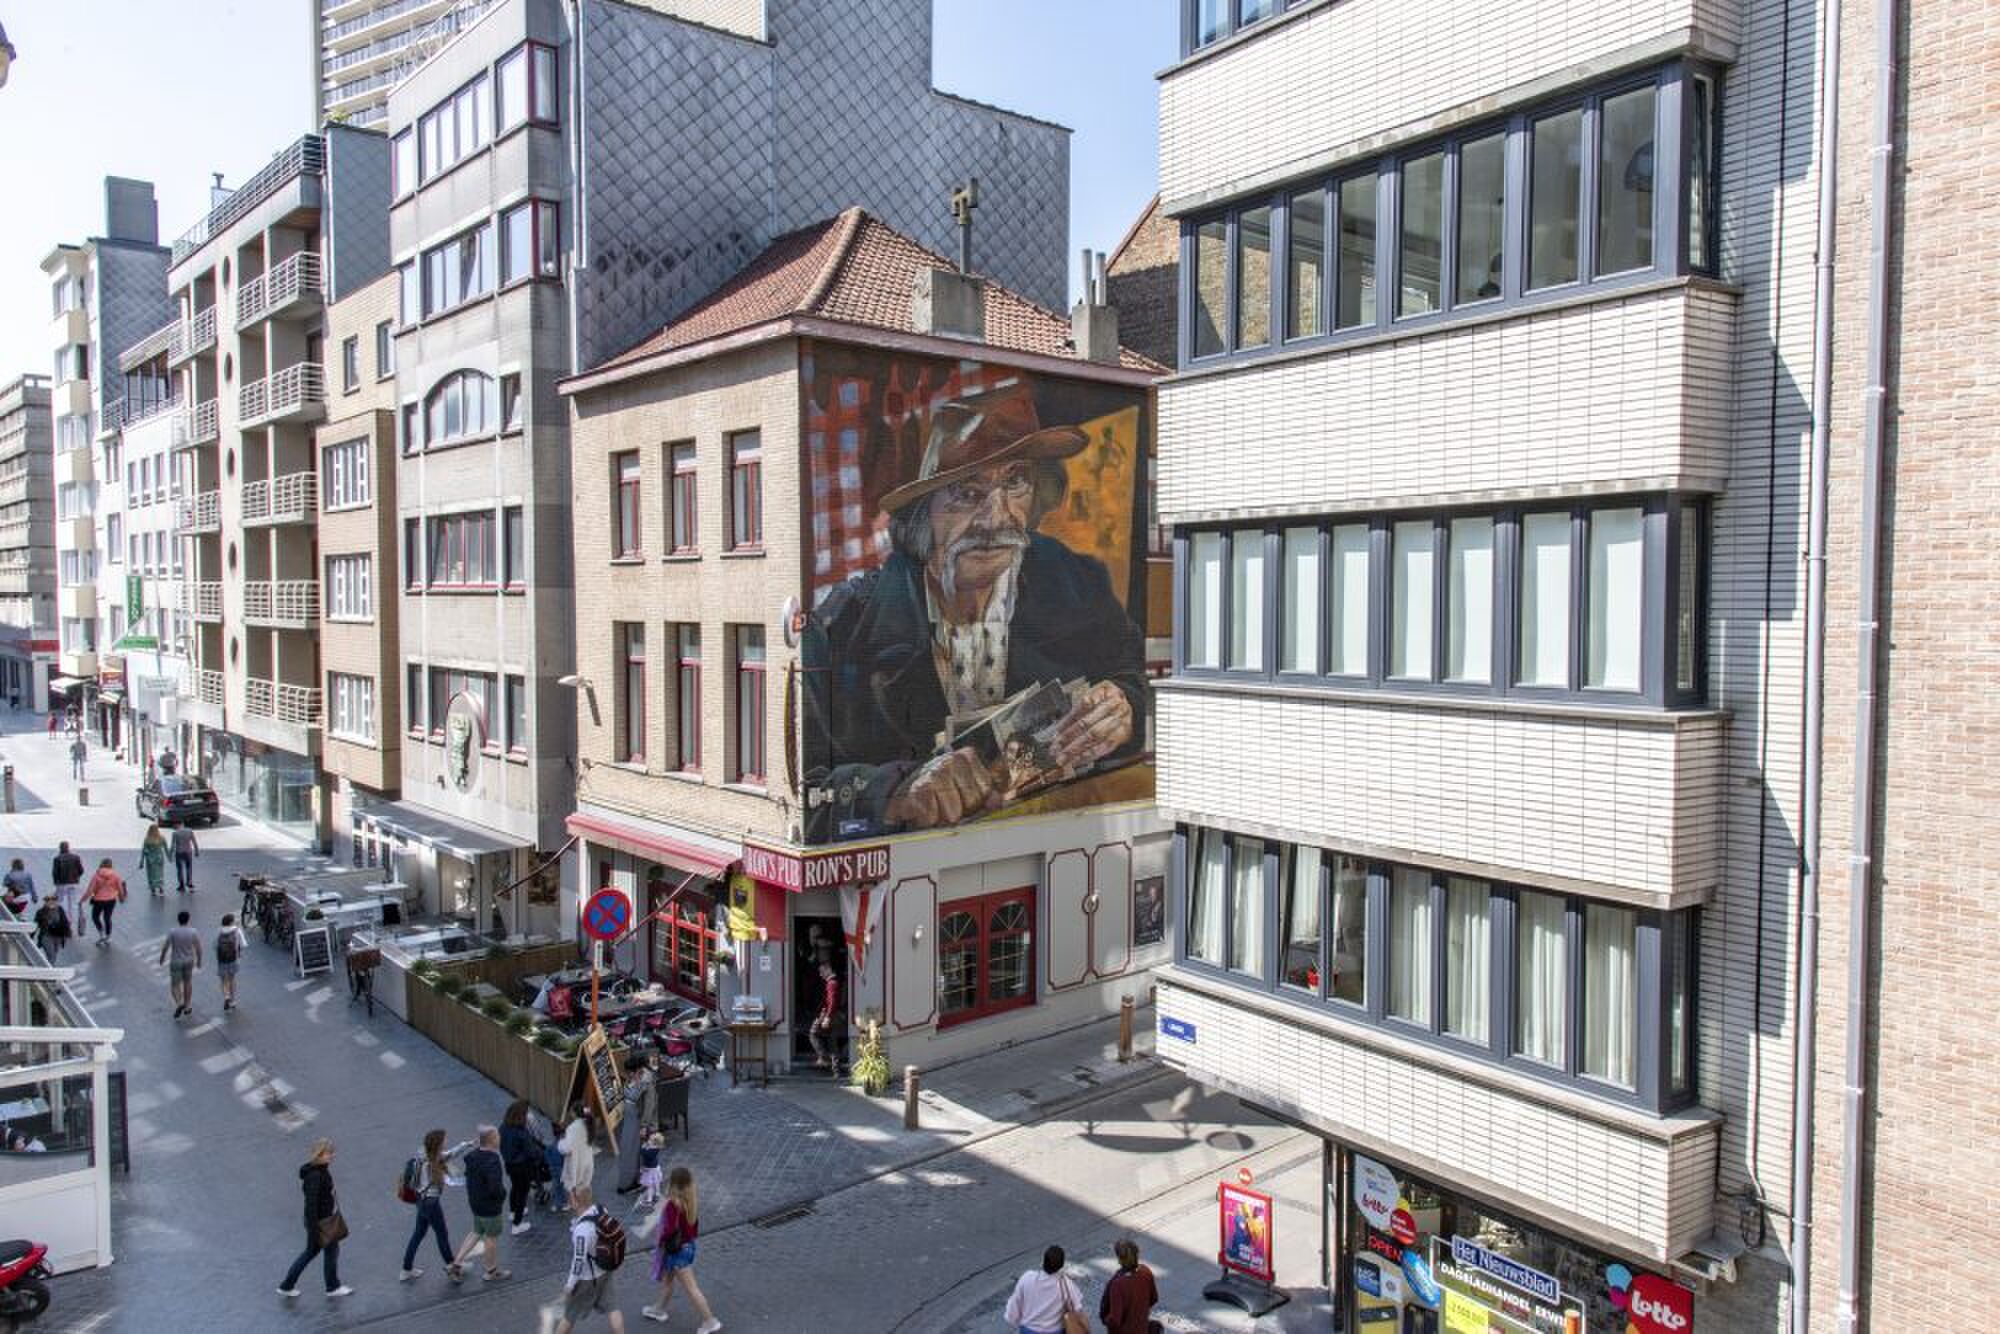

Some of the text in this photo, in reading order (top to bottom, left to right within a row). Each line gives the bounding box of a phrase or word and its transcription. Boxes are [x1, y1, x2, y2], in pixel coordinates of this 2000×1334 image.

[777, 855, 800, 886] PUB
[804, 849, 888, 888] RON'S PUB
[1440, 1261, 1531, 1312] DAGBLADHANDEL
[1455, 1243, 1476, 1265] Het
[1478, 1250, 1554, 1297] Nieuwsblad
